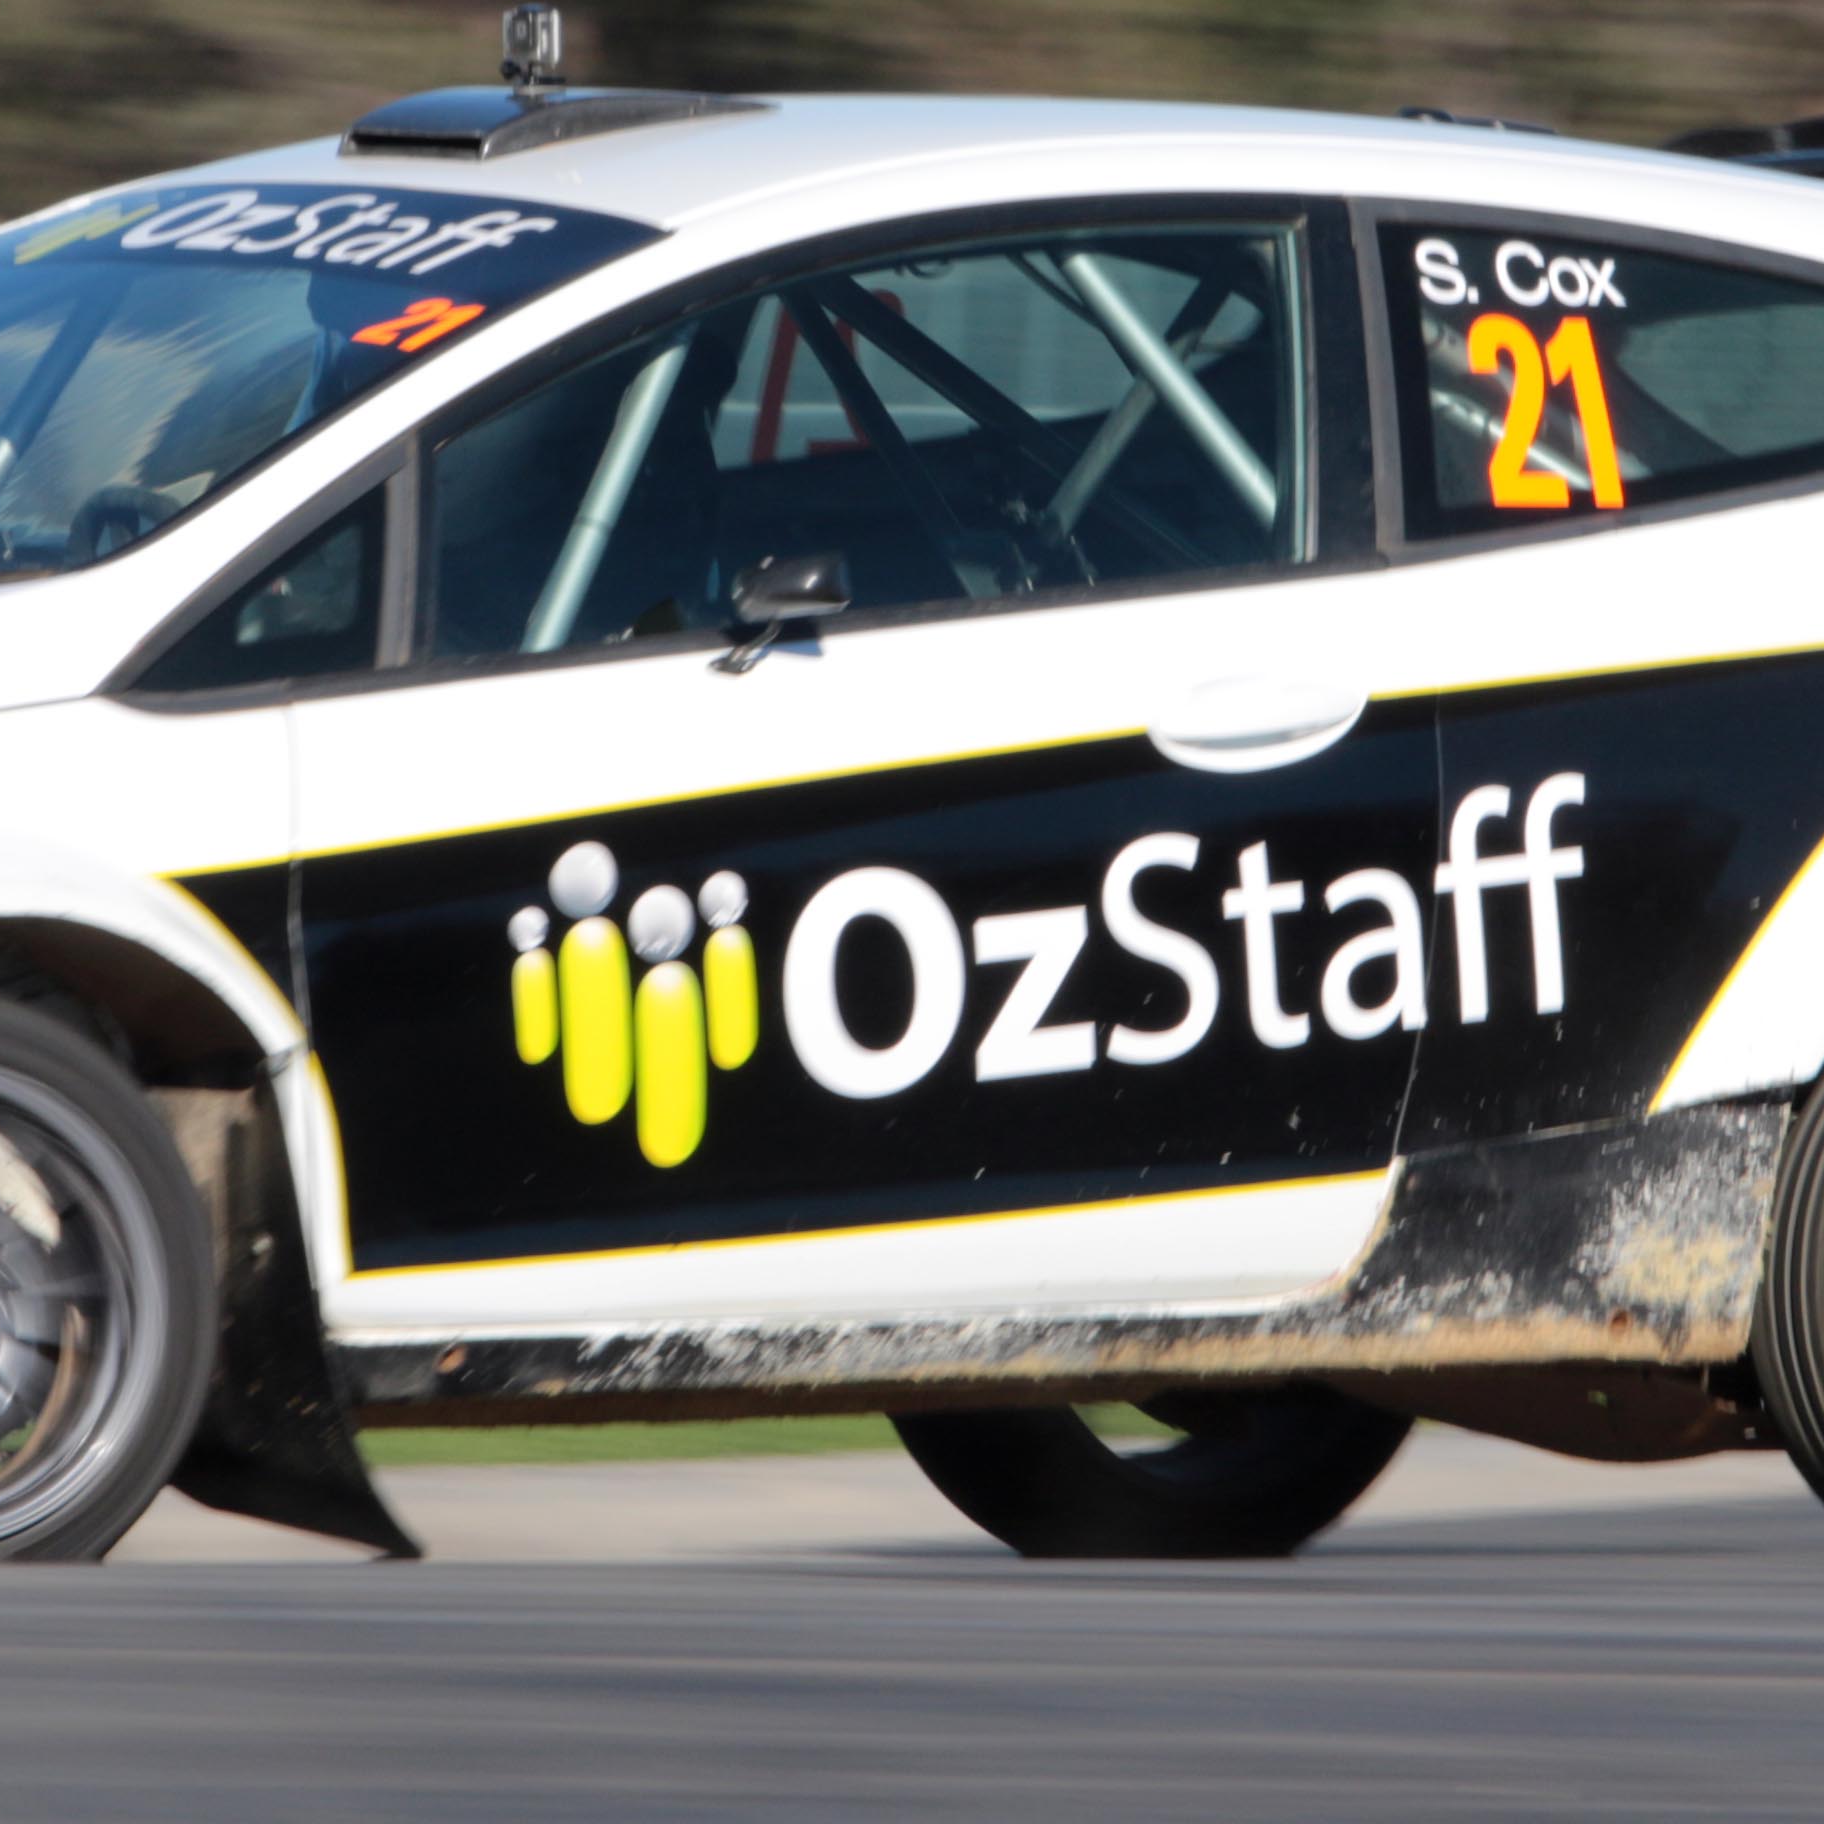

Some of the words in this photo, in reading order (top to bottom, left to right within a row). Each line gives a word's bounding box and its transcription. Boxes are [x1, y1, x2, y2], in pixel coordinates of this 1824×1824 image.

[120, 190, 558, 275] OzStaff
[1414, 238, 1479, 305] S.
[1495, 240, 1627, 307] Cox
[351, 297, 487, 352] 21
[1467, 312, 1625, 509] 21
[782, 771, 1586, 1099] OzStaff
